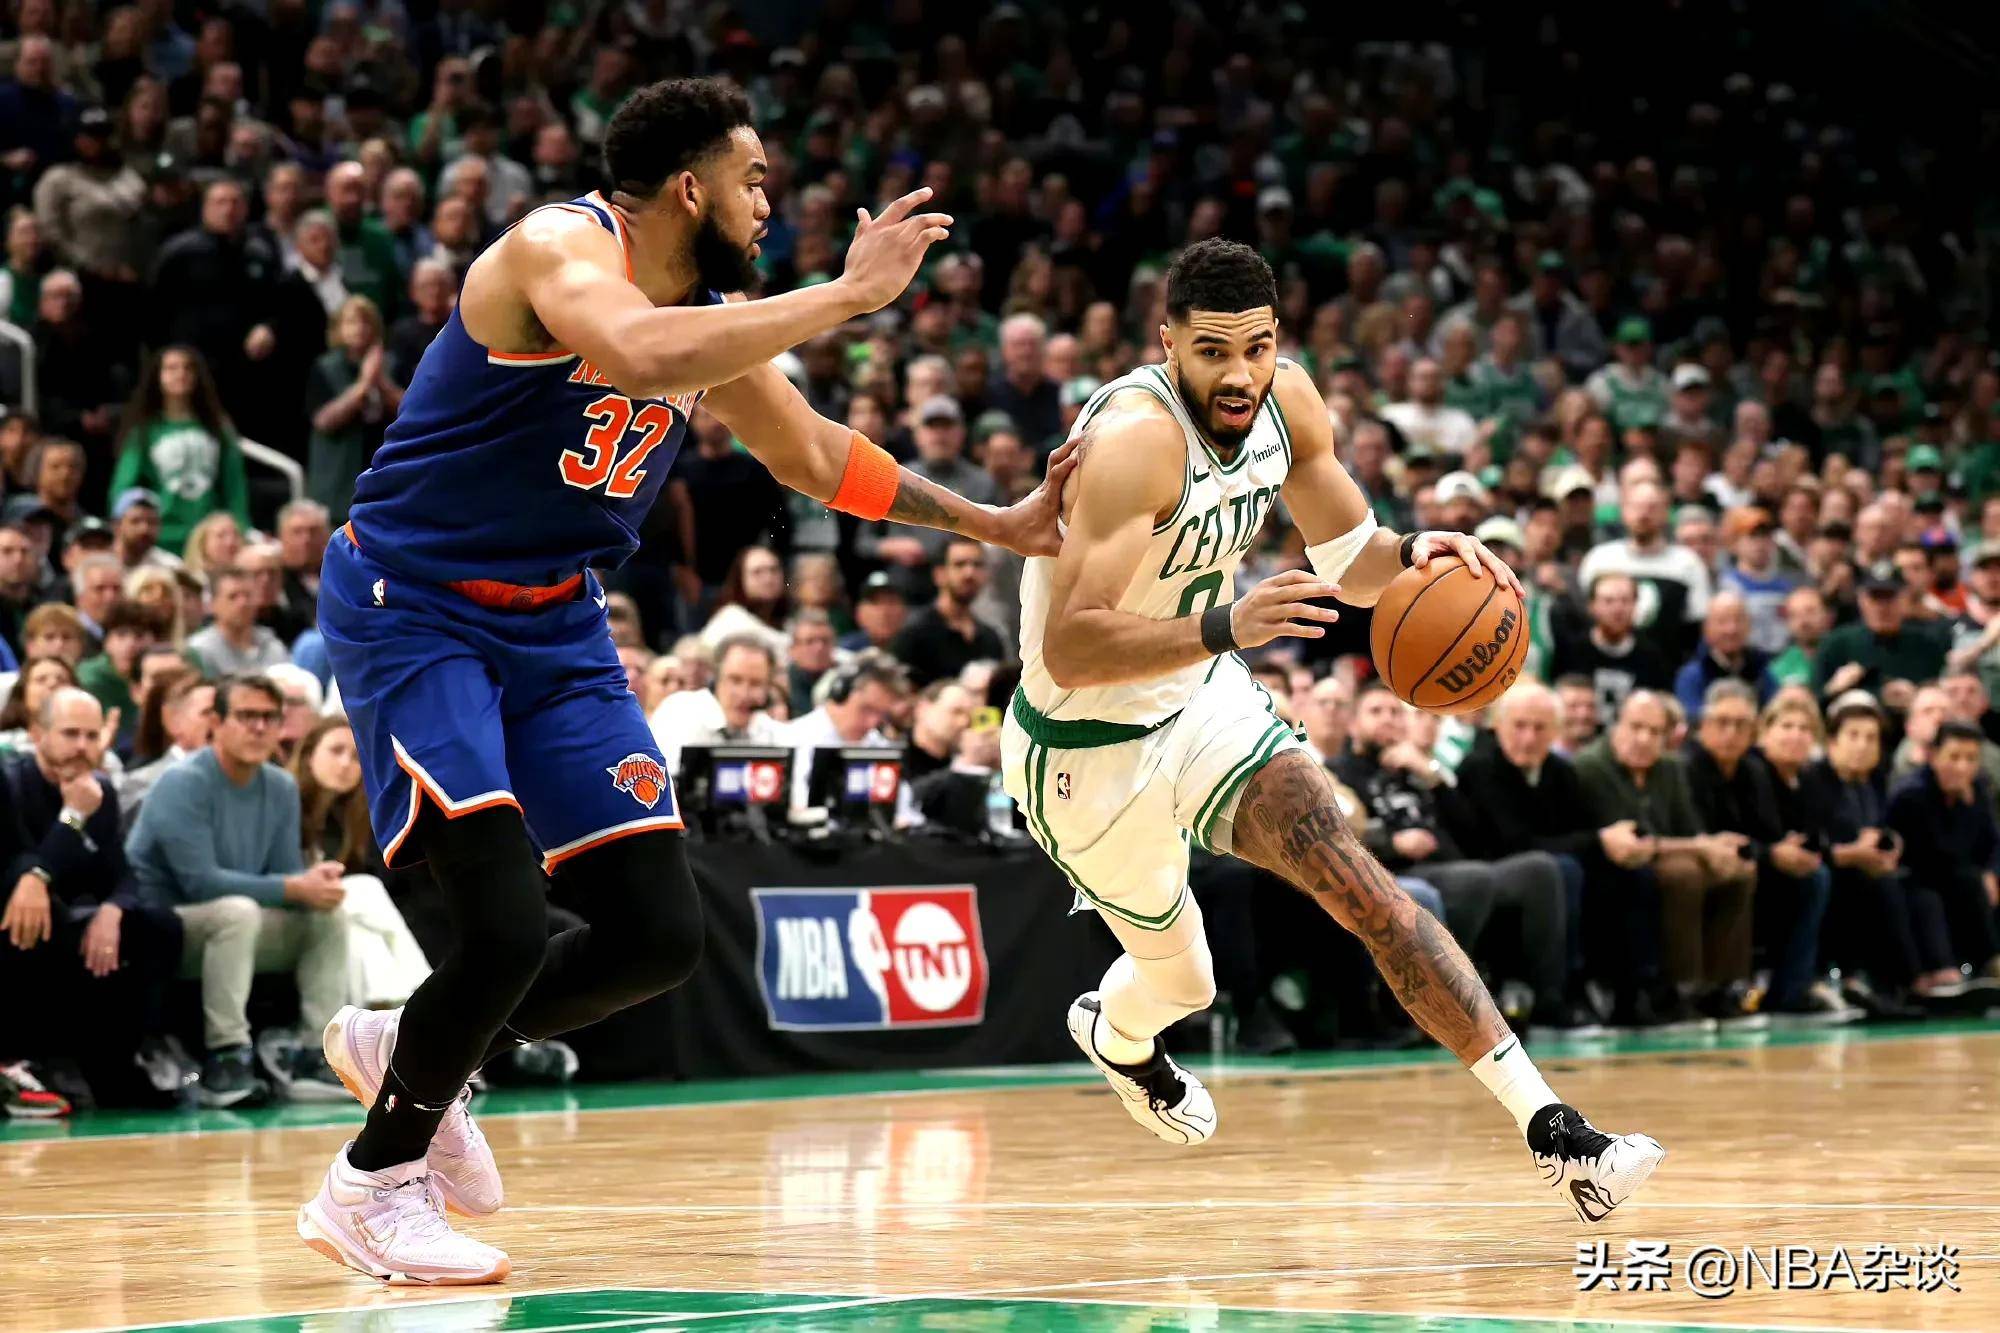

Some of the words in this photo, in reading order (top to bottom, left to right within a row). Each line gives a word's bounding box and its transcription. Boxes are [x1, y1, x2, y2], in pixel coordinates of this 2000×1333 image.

[558, 393, 673, 498] 32
[1251, 442, 1281, 466] Amica
[1435, 608, 1517, 693] Wilson
[616, 761, 666, 786] KNICKS
[776, 917, 848, 999] NBA
